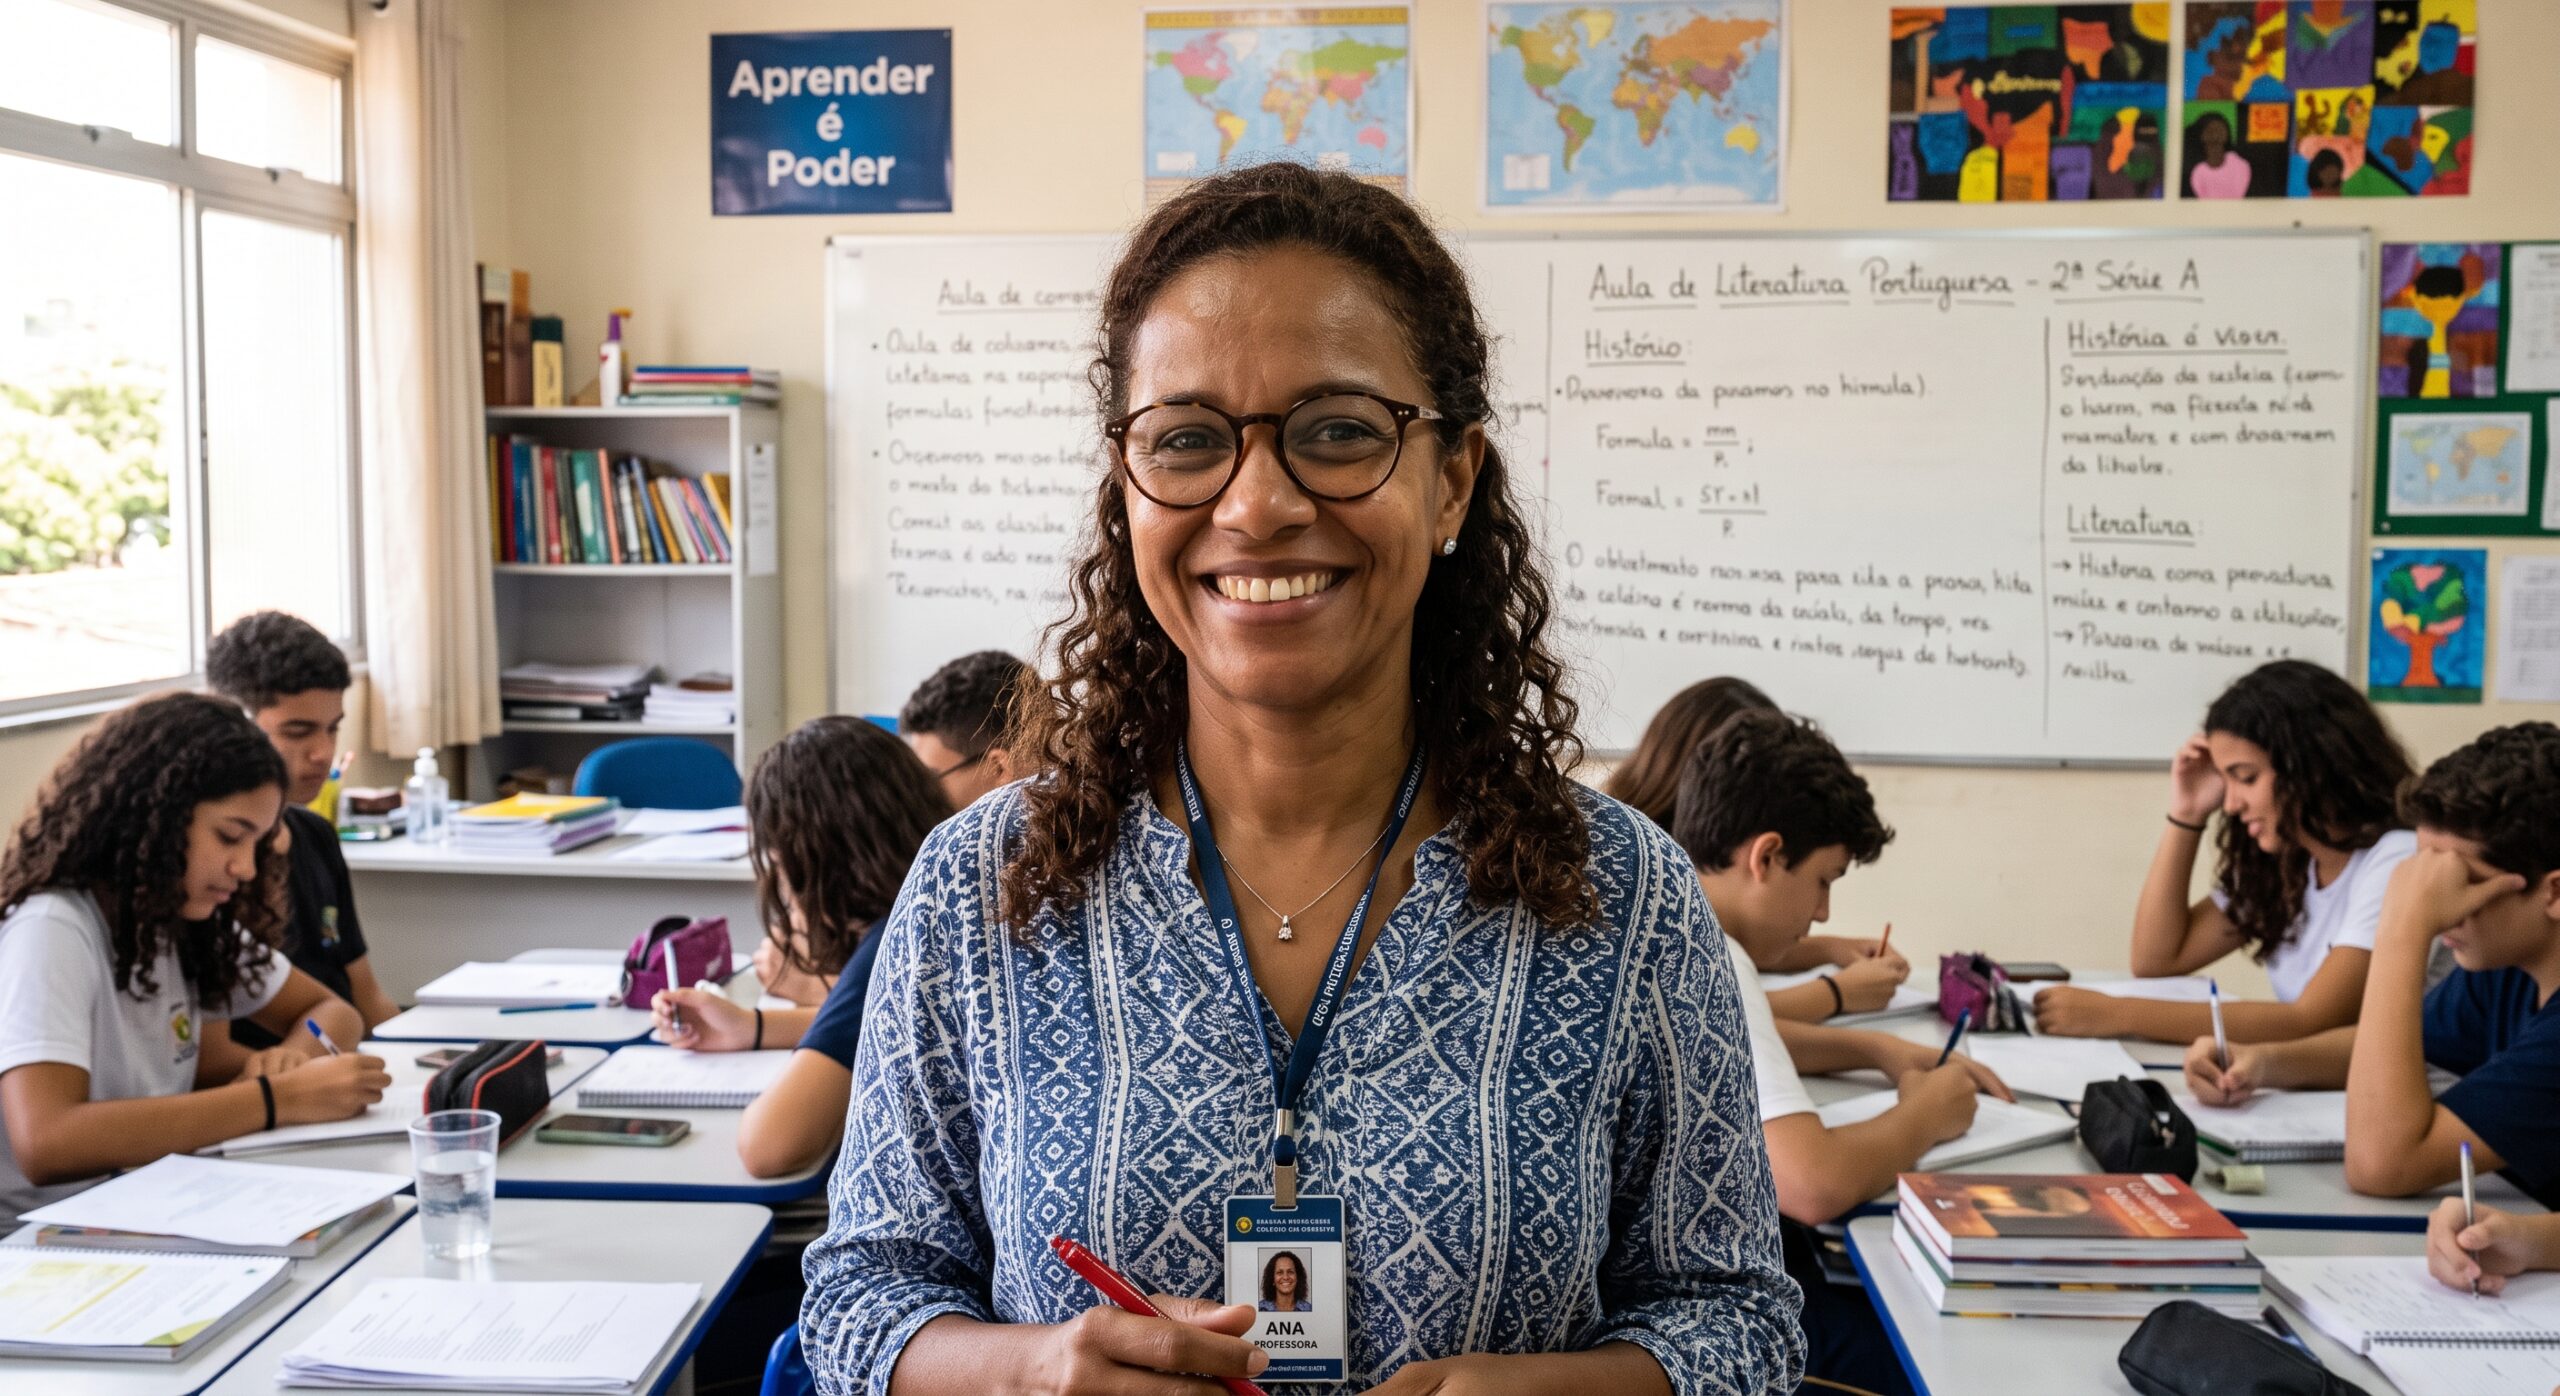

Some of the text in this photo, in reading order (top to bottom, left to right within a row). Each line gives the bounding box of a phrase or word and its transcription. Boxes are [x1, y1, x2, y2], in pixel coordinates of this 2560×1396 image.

[728, 56, 934, 104] Aprender
[816, 101, 844, 141] é
[768, 147, 896, 187] Poder
[938, 279, 986, 305] Aula
[999, 282, 1021, 305] de
[1590, 262, 1653, 300] Aula
[1669, 268, 1695, 298] de
[1715, 264, 1848, 298] Literatura
[1861, 257, 2012, 312] Portuguesa
[2096, 260, 2162, 291] Série
[2179, 258, 2199, 290] A
[950, 332, 972, 353] de
[2067, 321, 2169, 350] História
[1676, 380, 1699, 399] da
[1266, 1321, 1305, 1335] ANA
[1254, 1340, 1318, 1349] PROFESSORA
